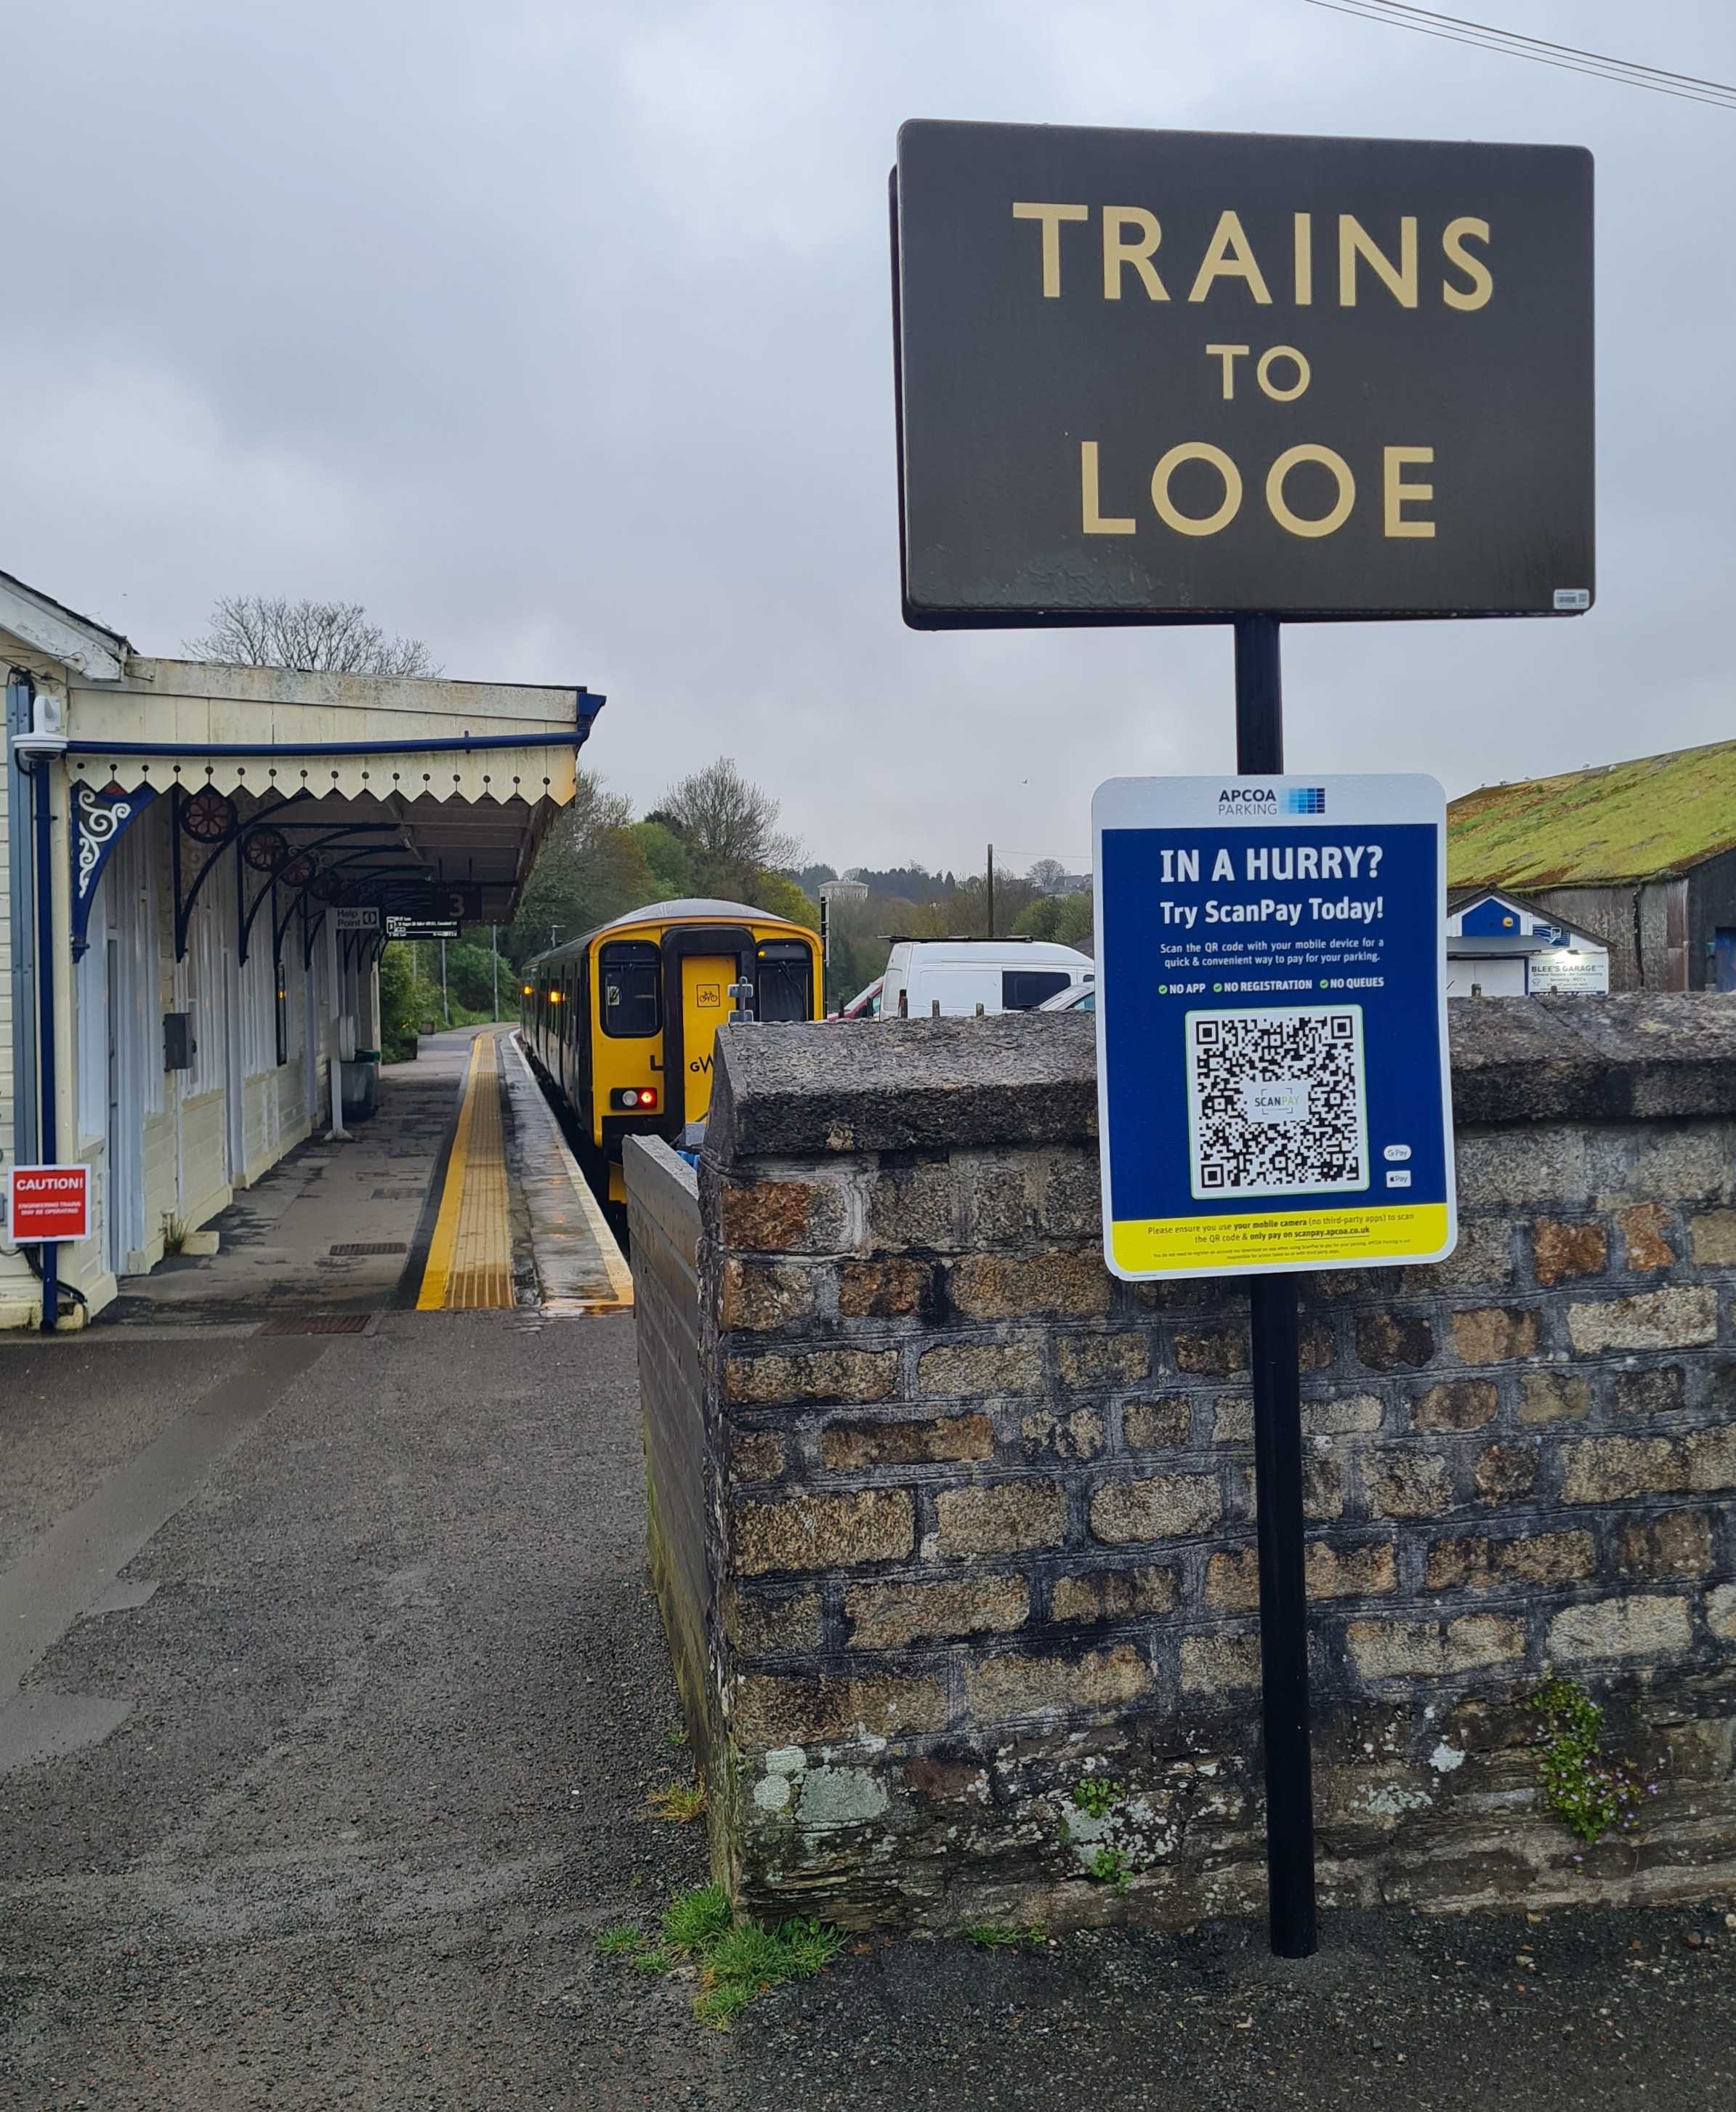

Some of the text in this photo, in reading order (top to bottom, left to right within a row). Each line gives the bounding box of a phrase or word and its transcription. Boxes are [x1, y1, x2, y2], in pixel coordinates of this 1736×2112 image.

[1012, 202, 1493, 311] TRAINS
[1206, 344, 1310, 401] TO
[1081, 441, 1436, 538] LOOE
[1219, 789, 1277, 802] APCOA
[1219, 803, 1277, 815] PARKING
[1160, 845, 1383, 883] IN A HURRY?
[449, 893, 464, 916] 3
[337, 909, 358, 919] Help
[1160, 896, 1383, 930] Try ScanPay Today!
[1160, 943, 1182, 954] Scan
[1186, 943, 1201, 952] the
[1205, 943, 1219, 953] QR
[1222, 942, 1244, 951] code
[1247, 940, 1267, 951] with
[1270, 942, 1291, 952] your
[1295, 939, 1326, 949] mobile
[1330, 938, 1359, 948] device
[1362, 938, 1375, 947] for
[1164, 951, 1380, 970] quick & convenient way to pay for your parking.
[1169, 983, 1206, 994] NO APP
[1224, 980, 1312, 992] NO REGISTRATION
[1330, 977, 1384, 989] NO QUEUES
[1255, 1096, 1299, 1107] SCANPAY
[16, 1177, 84, 1191] CAUTION!
[1309, 1218, 1321, 1227] (no
[1323, 1215, 1363, 1225] third-party
[1365, 1214, 1386, 1223] apps)
[1294, 1226, 1370, 1238] scanpay.apcoa.co.uk
